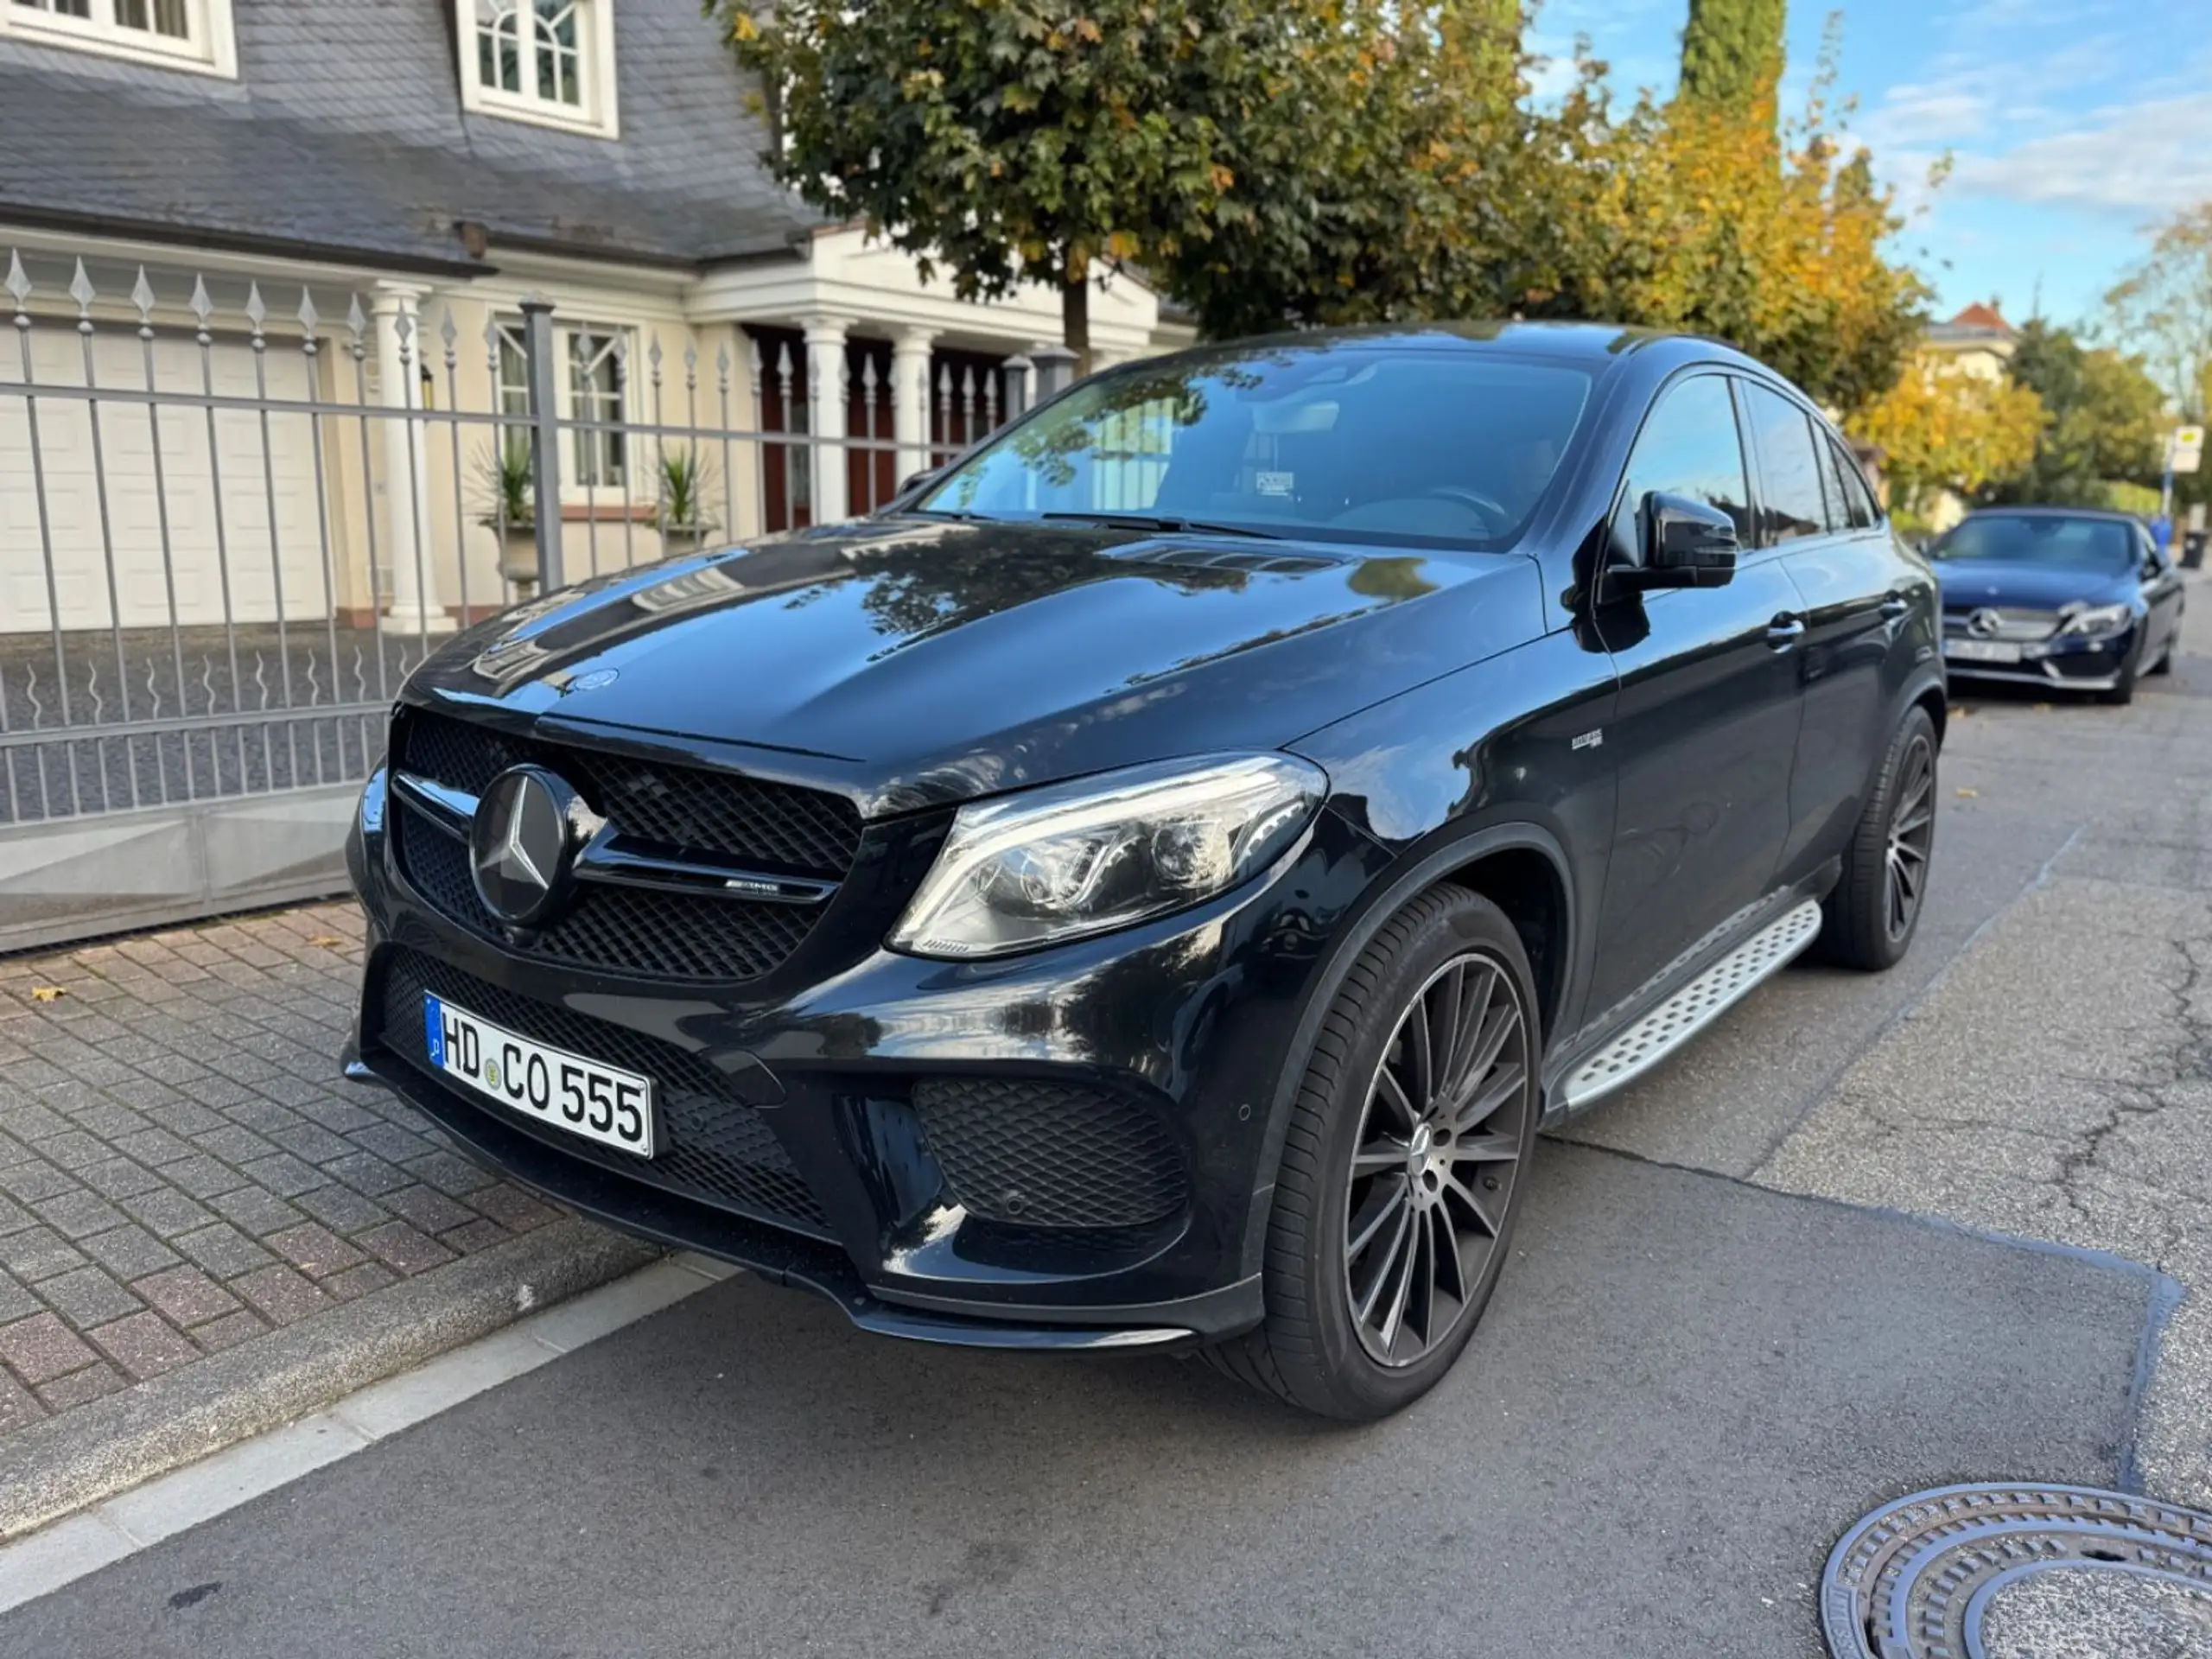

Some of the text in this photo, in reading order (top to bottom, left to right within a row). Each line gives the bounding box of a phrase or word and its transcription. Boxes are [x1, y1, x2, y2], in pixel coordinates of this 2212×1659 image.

[442, 1012, 642, 1141] HD CO 555
